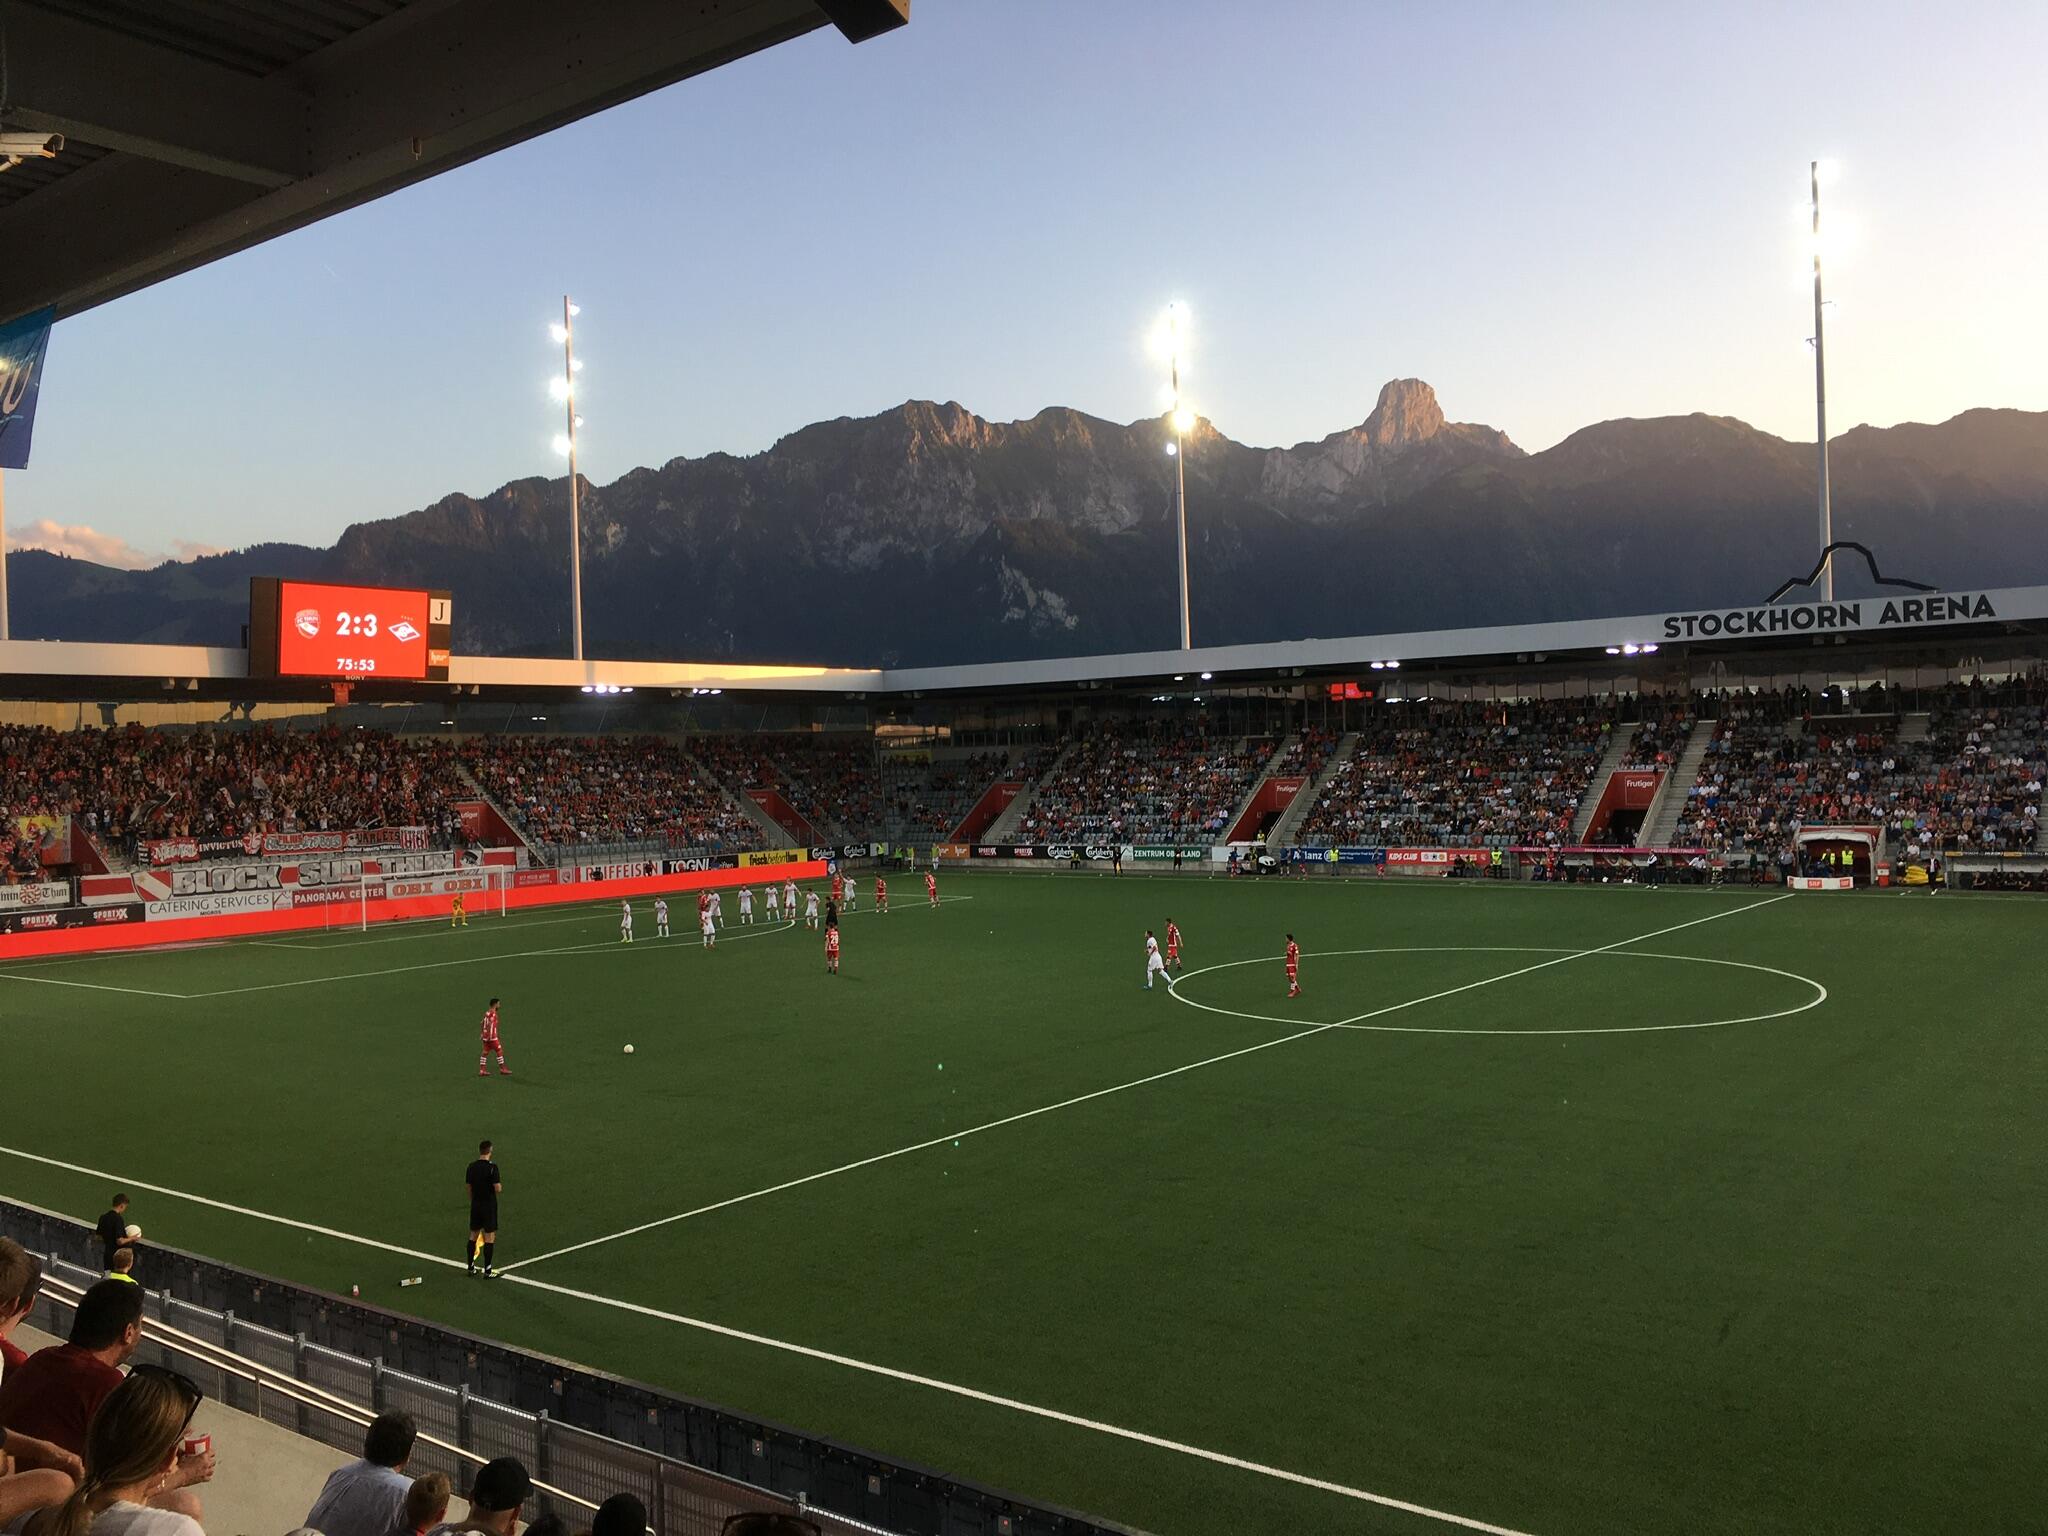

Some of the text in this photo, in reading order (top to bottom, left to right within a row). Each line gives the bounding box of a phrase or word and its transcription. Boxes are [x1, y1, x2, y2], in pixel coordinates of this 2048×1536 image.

[435, 602, 443, 621] J
[1664, 593, 1996, 638] STOCKHORN ARENA
[336, 612, 377, 637] 2:3
[336, 658, 375, 671] 75:53
[1276, 785, 1297, 793] Frutiger
[1627, 780, 1654, 788] Frutiger
[200, 840, 243, 852] INVICTUS
[844, 844, 866, 858] Carlsberg
[1086, 845, 1114, 860] Carlsberg
[812, 847, 836, 860] Carlsberg
[1134, 850, 1165, 858] ZENTRUM
[172, 865, 282, 896] BLOCK
[444, 879, 483, 892] OBI
[393, 882, 433, 896] OBI
[149, 894, 269, 914] CATERING SERVICES
[294, 892, 345, 903] PANORAMA
[21, 914, 58, 926] SPORTXX
[93, 908, 128, 920] SPORTXX
